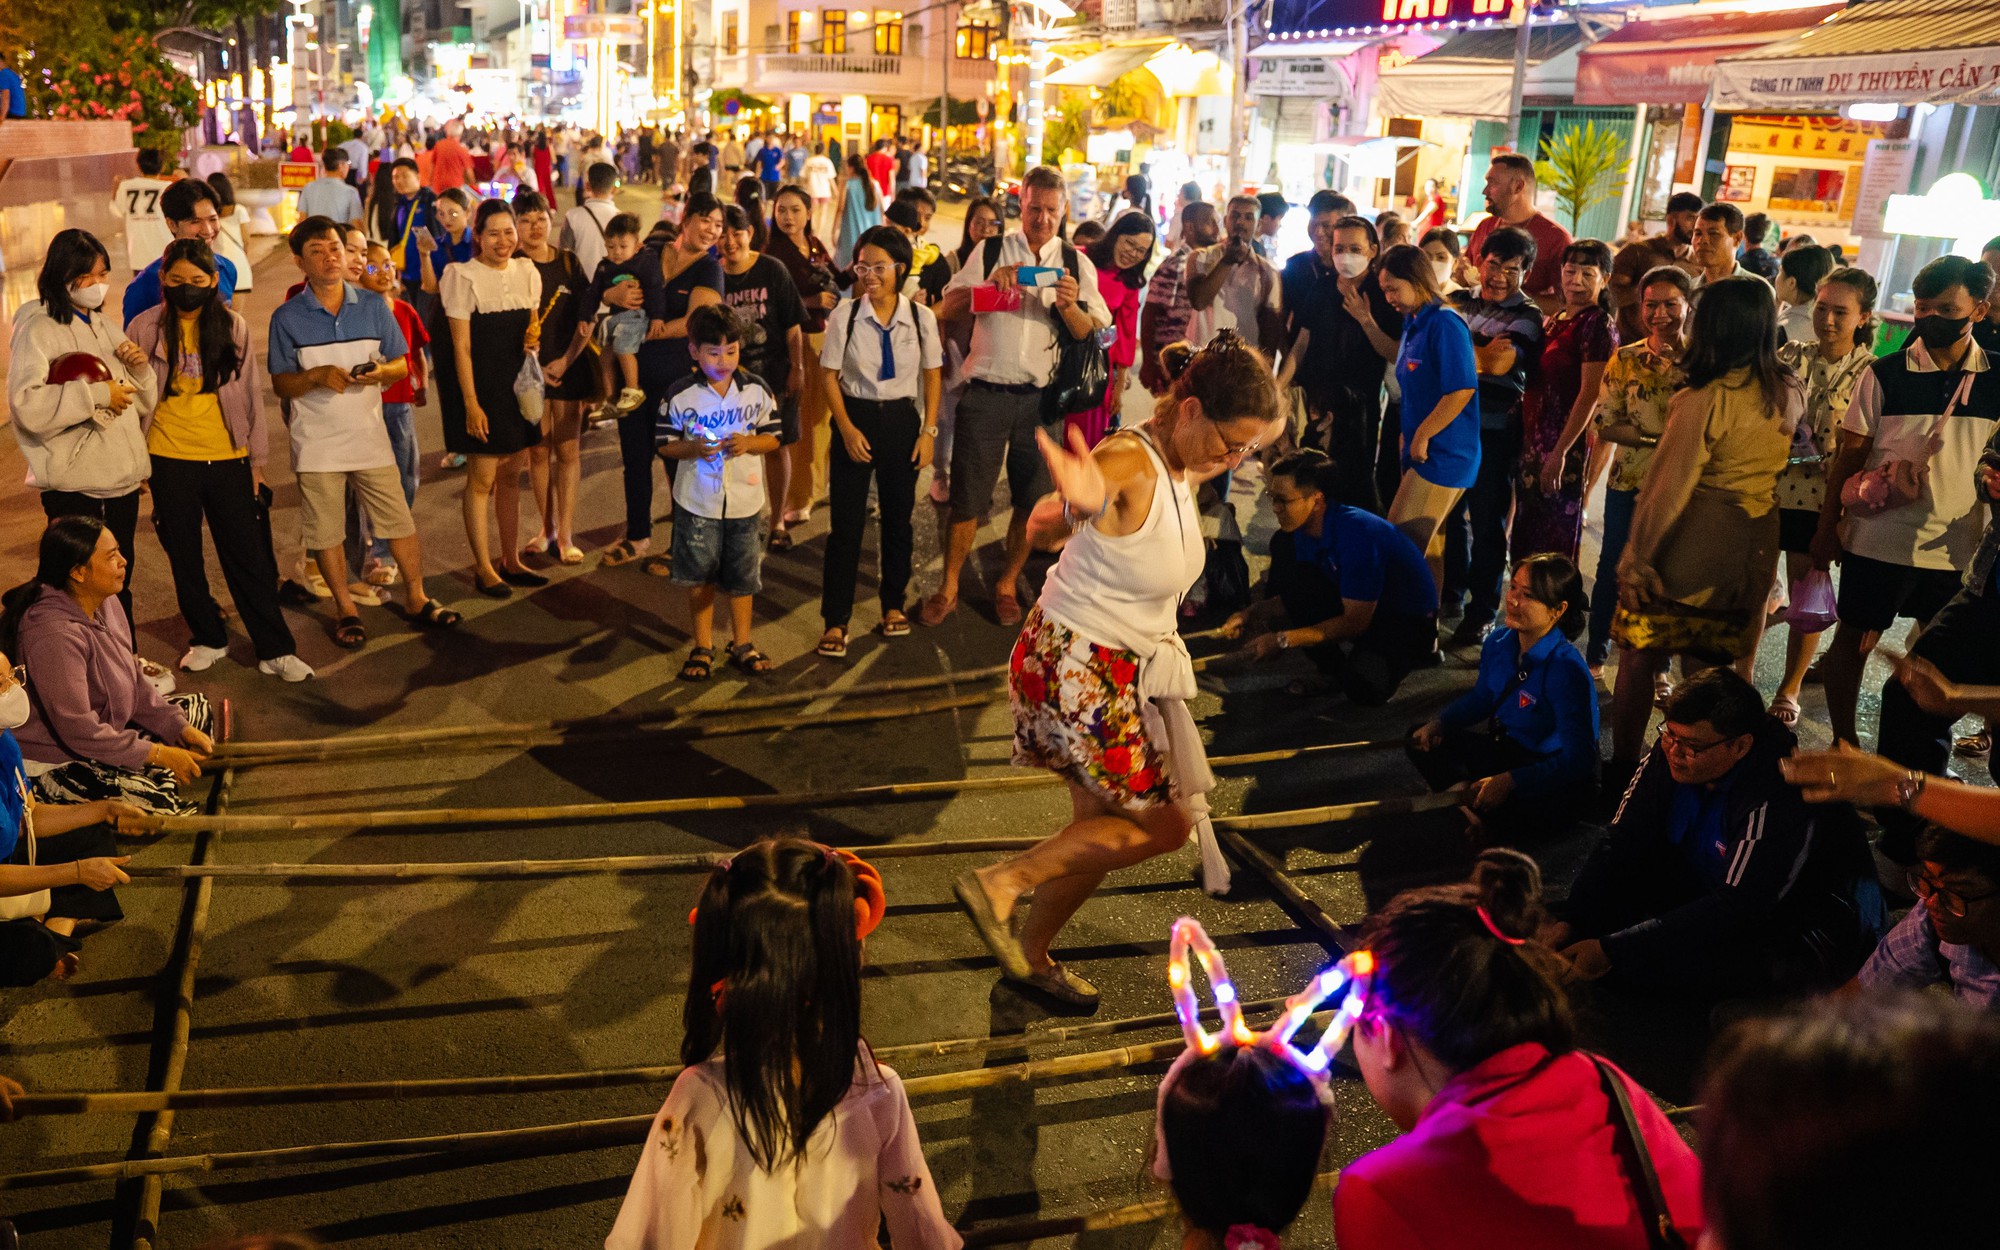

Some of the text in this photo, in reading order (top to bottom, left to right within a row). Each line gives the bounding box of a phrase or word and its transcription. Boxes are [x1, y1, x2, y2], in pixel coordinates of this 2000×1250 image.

[1781, 77, 1793, 92] TY
[1796, 77, 1824, 92] TNHH
[1827, 73, 1853, 93] DU
[1857, 61, 1935, 92] THUYỀN
[1939, 58, 1984, 88] CẦN
[127, 190, 159, 214] 77
[725, 286, 769, 306] ONEKA
